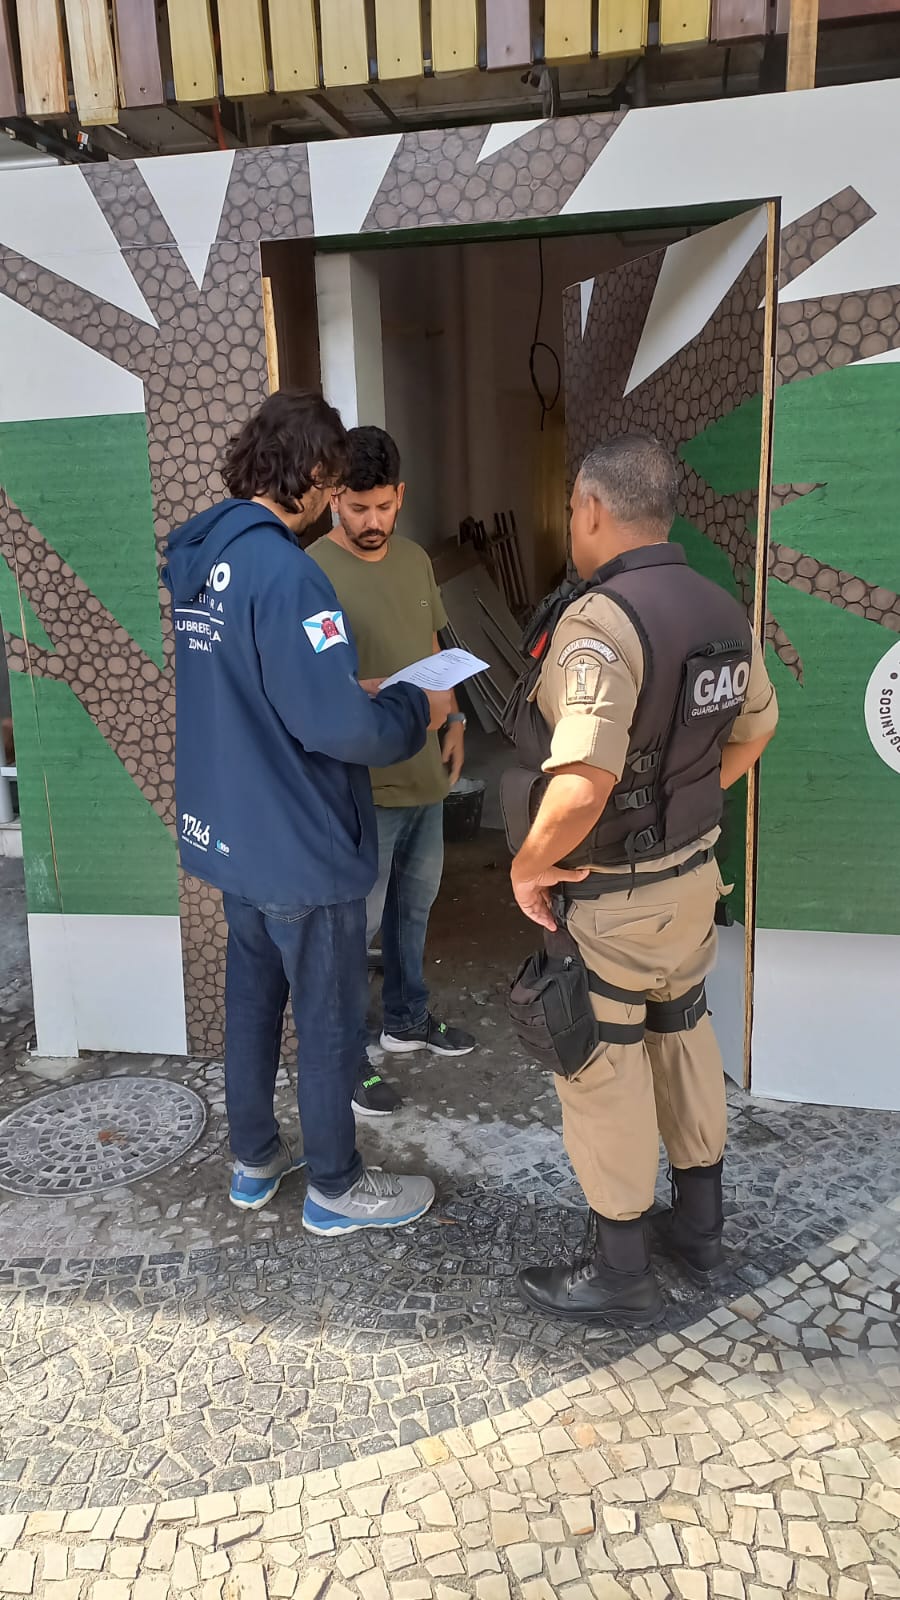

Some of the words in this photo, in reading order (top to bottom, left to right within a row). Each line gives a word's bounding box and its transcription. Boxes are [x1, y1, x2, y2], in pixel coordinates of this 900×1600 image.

[694, 661, 750, 706] GAO
[691, 703, 720, 717] GUARDA
[182, 813, 210, 845] 1746
